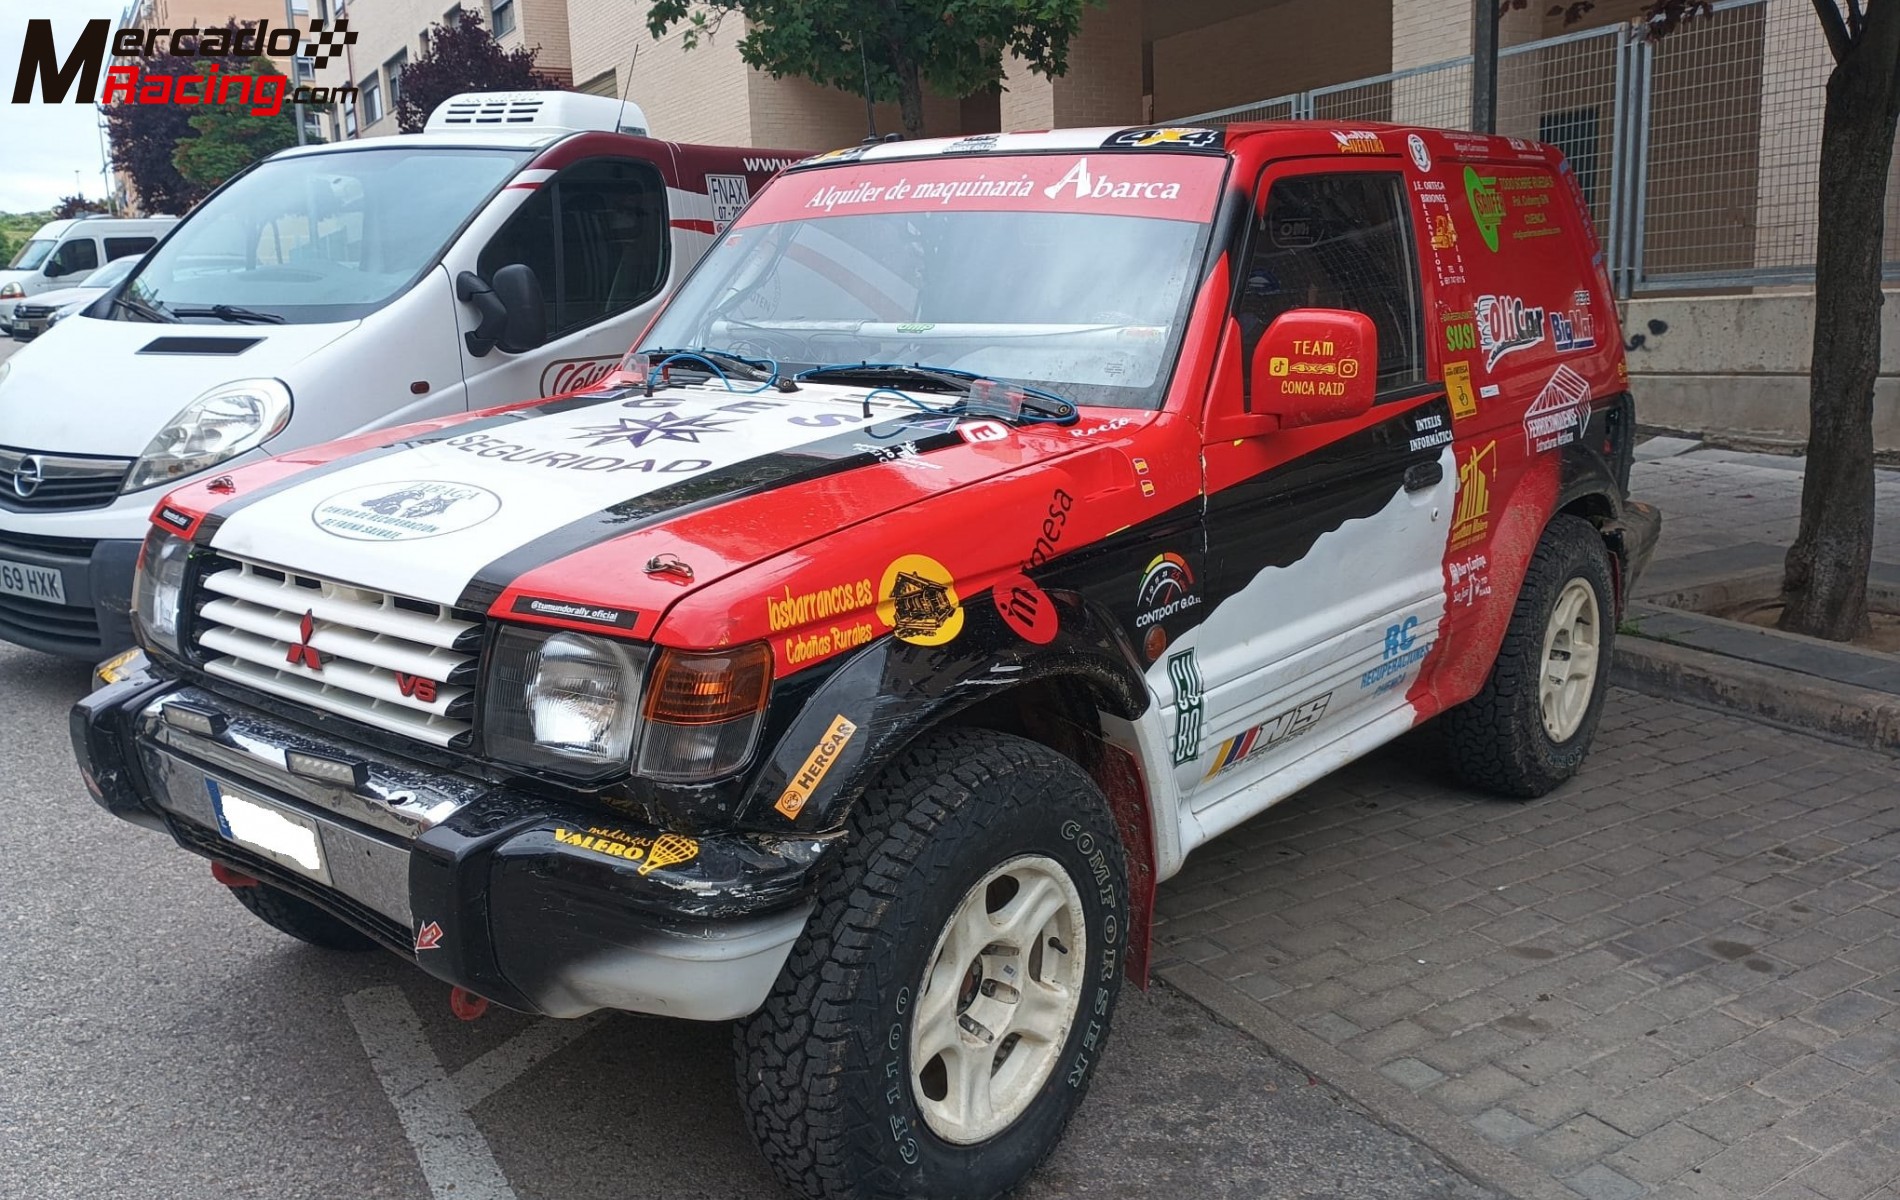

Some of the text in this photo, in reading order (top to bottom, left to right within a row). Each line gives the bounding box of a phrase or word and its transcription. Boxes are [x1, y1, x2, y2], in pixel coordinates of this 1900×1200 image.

[711, 178, 747, 205] FNAX
[805, 158, 1181, 212] Alquiler de maquinaria Abarca
[1420, 194, 1447, 203] BRIONES
[1424, 181, 1445, 190] ORTEGA
[1446, 322, 1476, 352] SUSI
[1550, 309, 1595, 348] BigMat
[1293, 340, 1334, 356] TEAM
[1281, 380, 1345, 396] CONCA RAID
[1066, 417, 1132, 437] Rocío
[1415, 414, 1442, 432] INTELIS
[448, 433, 713, 474] SEGURIDAD
[1410, 429, 1454, 452] INFORMÁTICA
[26, 568, 61, 600] HXK
[767, 578, 873, 631] losbarrancos.es
[785, 622, 873, 665] Cabañas Rurales
[1383, 615, 1418, 660] RC
[394, 671, 437, 704] V6
[554, 828, 645, 861] VALERO
[588, 826, 654, 849] mudanzas
[1060, 818, 1118, 1089] COMFORSER
